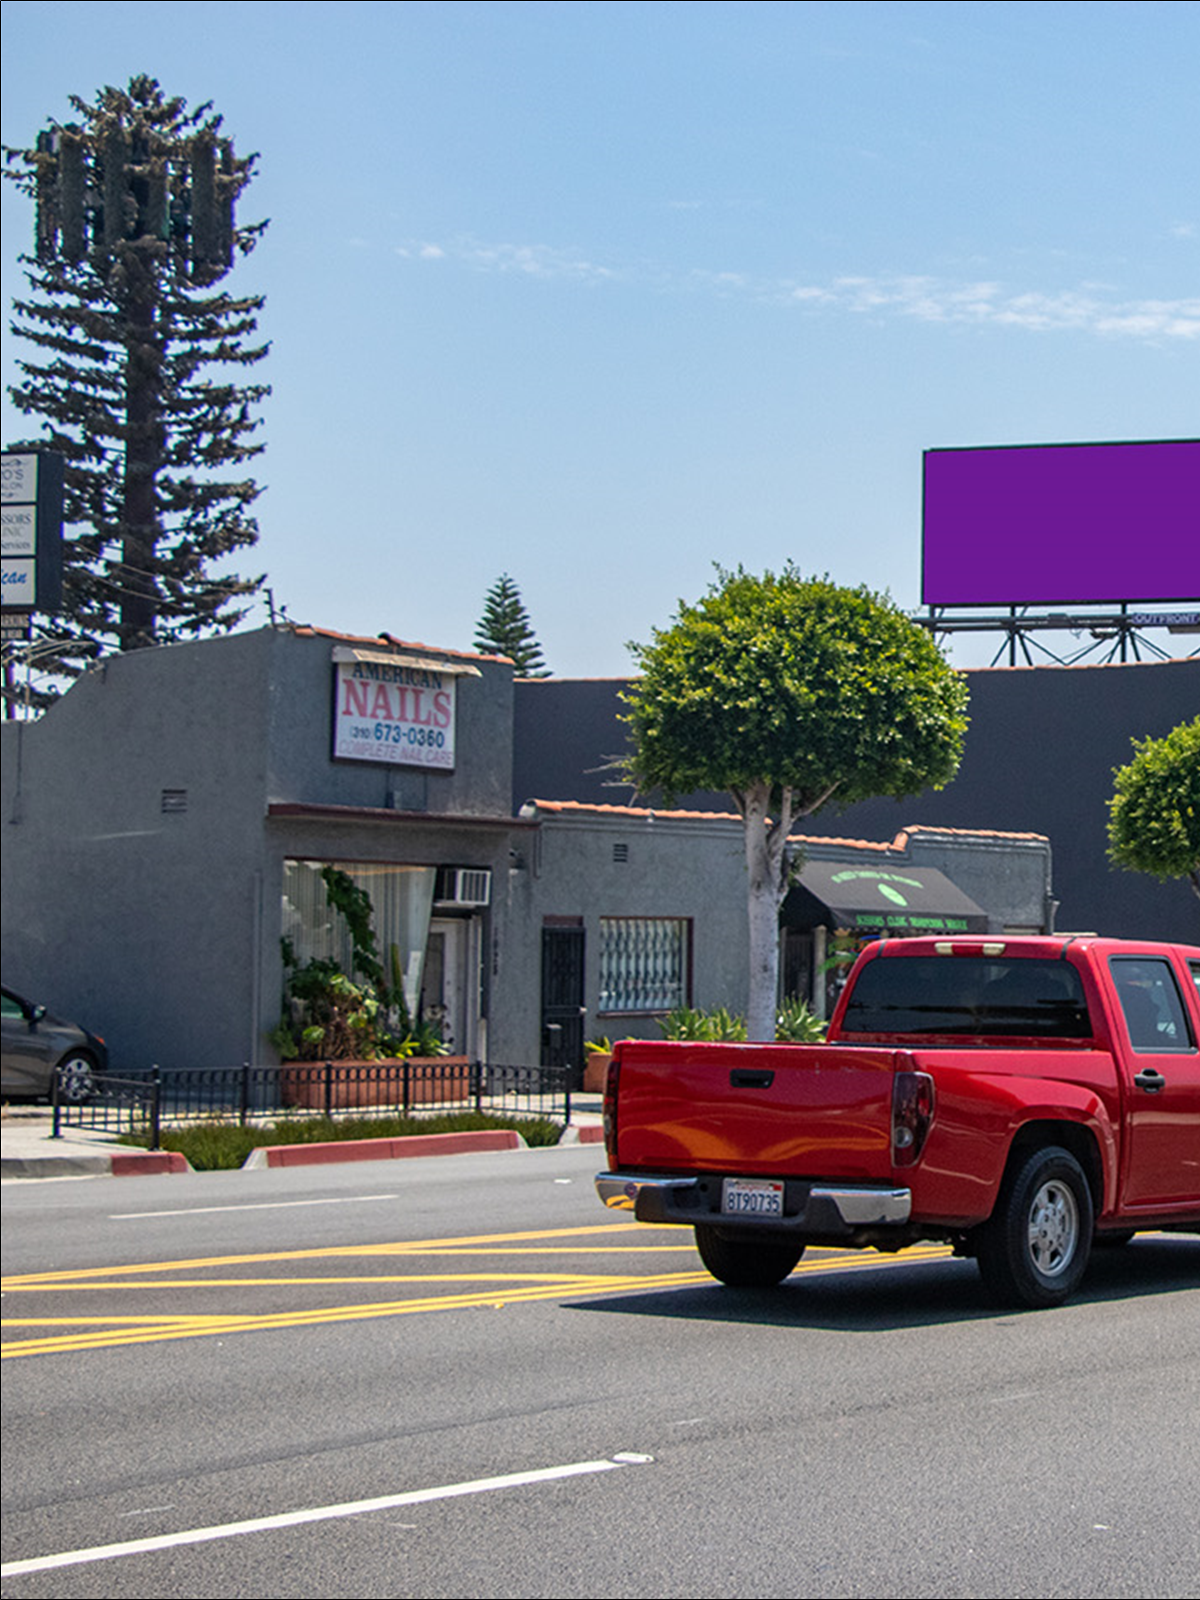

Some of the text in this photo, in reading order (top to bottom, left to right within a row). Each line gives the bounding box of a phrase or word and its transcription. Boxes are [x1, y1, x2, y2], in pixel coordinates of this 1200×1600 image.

[1134, 613, 1196, 623] OUTFRONT
[352, 662, 442, 690] AMERICAN
[342, 678, 452, 729] NAILS
[374, 722, 446, 748] 673-0360
[339, 739, 454, 766] COMPLETE NAIL CARE
[727, 1192, 780, 1213] 8T90735
